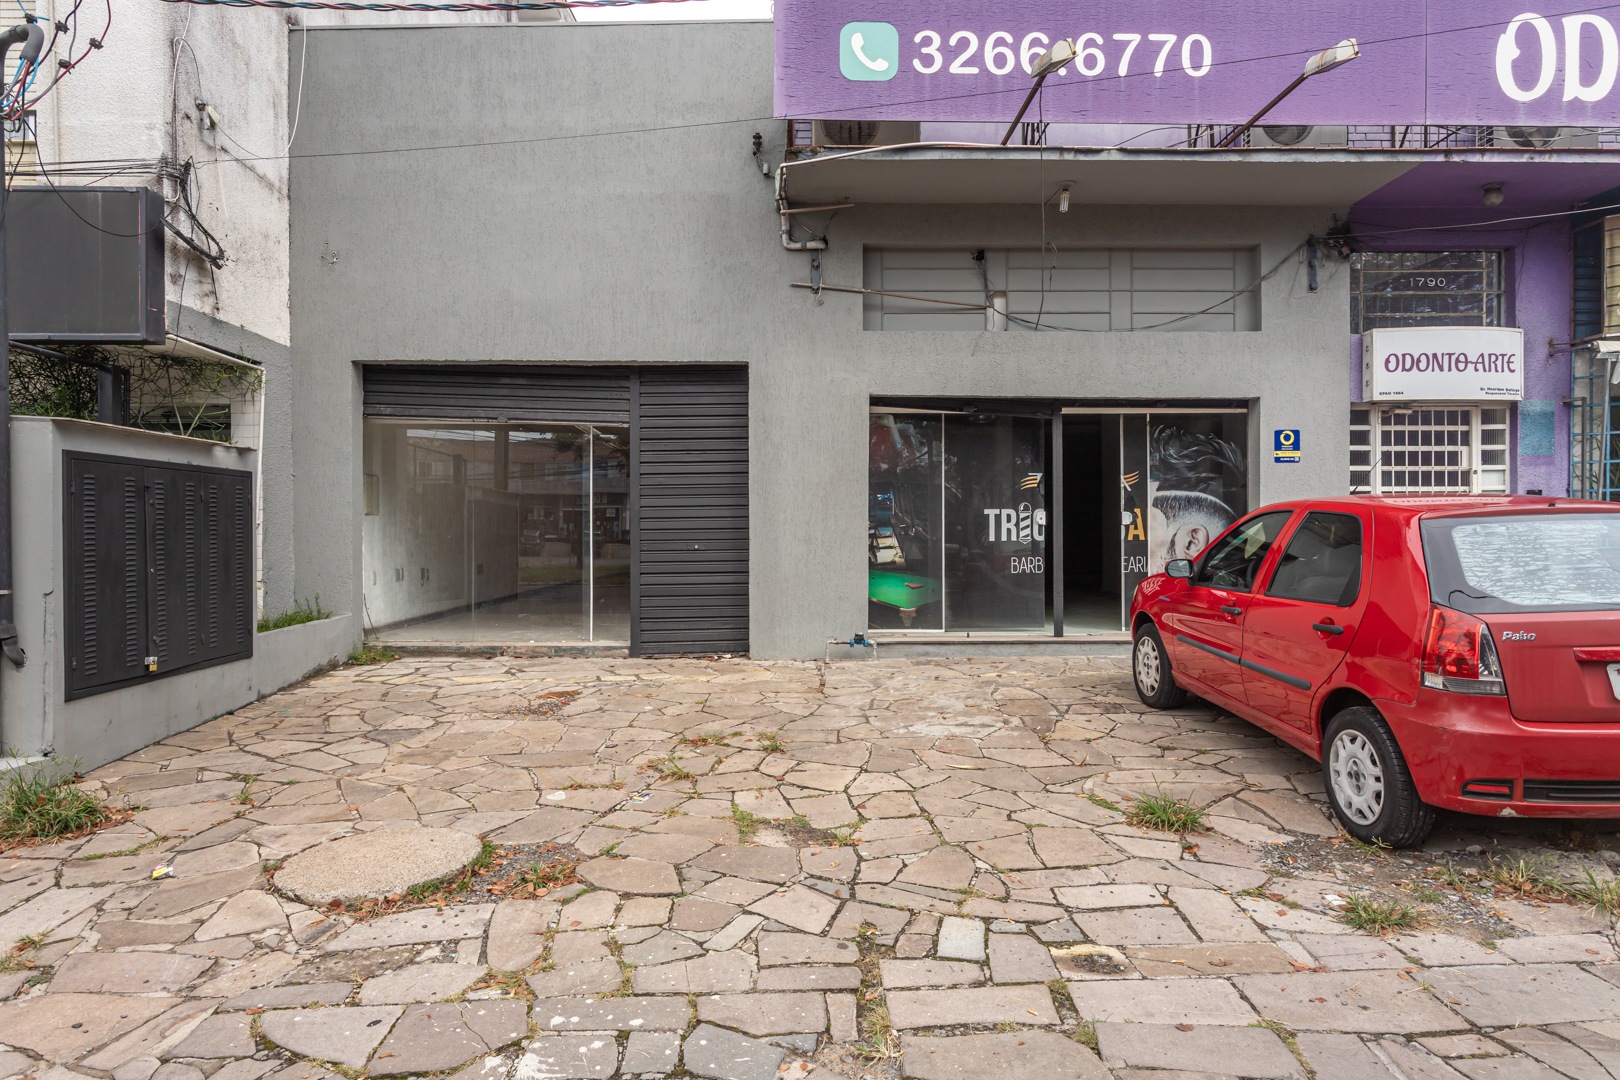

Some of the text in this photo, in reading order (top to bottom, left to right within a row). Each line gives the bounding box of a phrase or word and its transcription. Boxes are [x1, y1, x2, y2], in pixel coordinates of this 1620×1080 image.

[912, 30, 1212, 77] 3266.6770
[1410, 277, 1446, 287] 1790
[1384, 352, 1516, 373] ODONTO-ARTE
[1502, 631, 1537, 642] Palio
